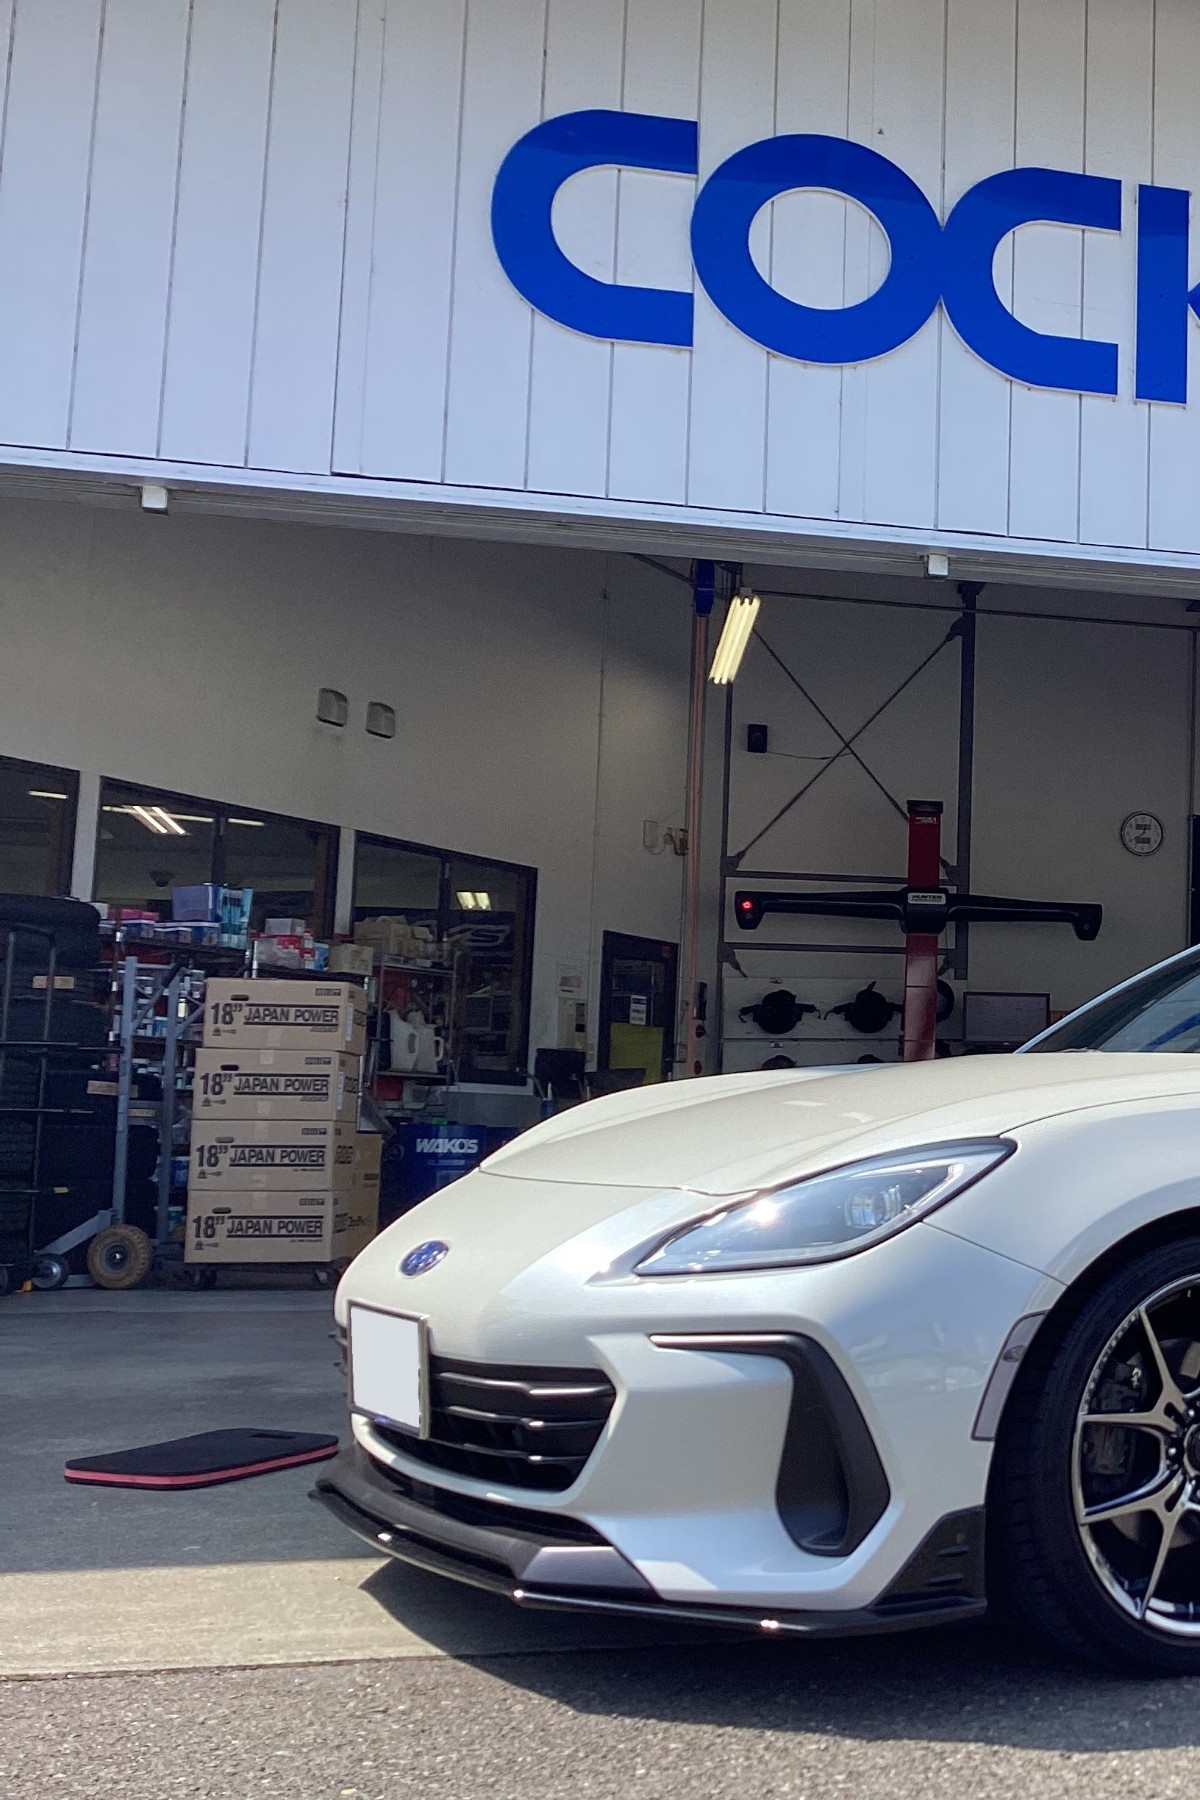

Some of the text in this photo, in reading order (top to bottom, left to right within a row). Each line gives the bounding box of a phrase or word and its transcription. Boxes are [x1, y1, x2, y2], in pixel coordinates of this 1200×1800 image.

[244, 1008, 290, 1023] JAPAN
[294, 1010, 339, 1023] POWER
[233, 1078, 279, 1092] JAPAN
[284, 1079, 329, 1092] POWER
[229, 1149, 275, 1164] JAPAN
[280, 1150, 325, 1163] POWER
[226, 1220, 272, 1234] JAPAN
[277, 1221, 323, 1234] POWER
